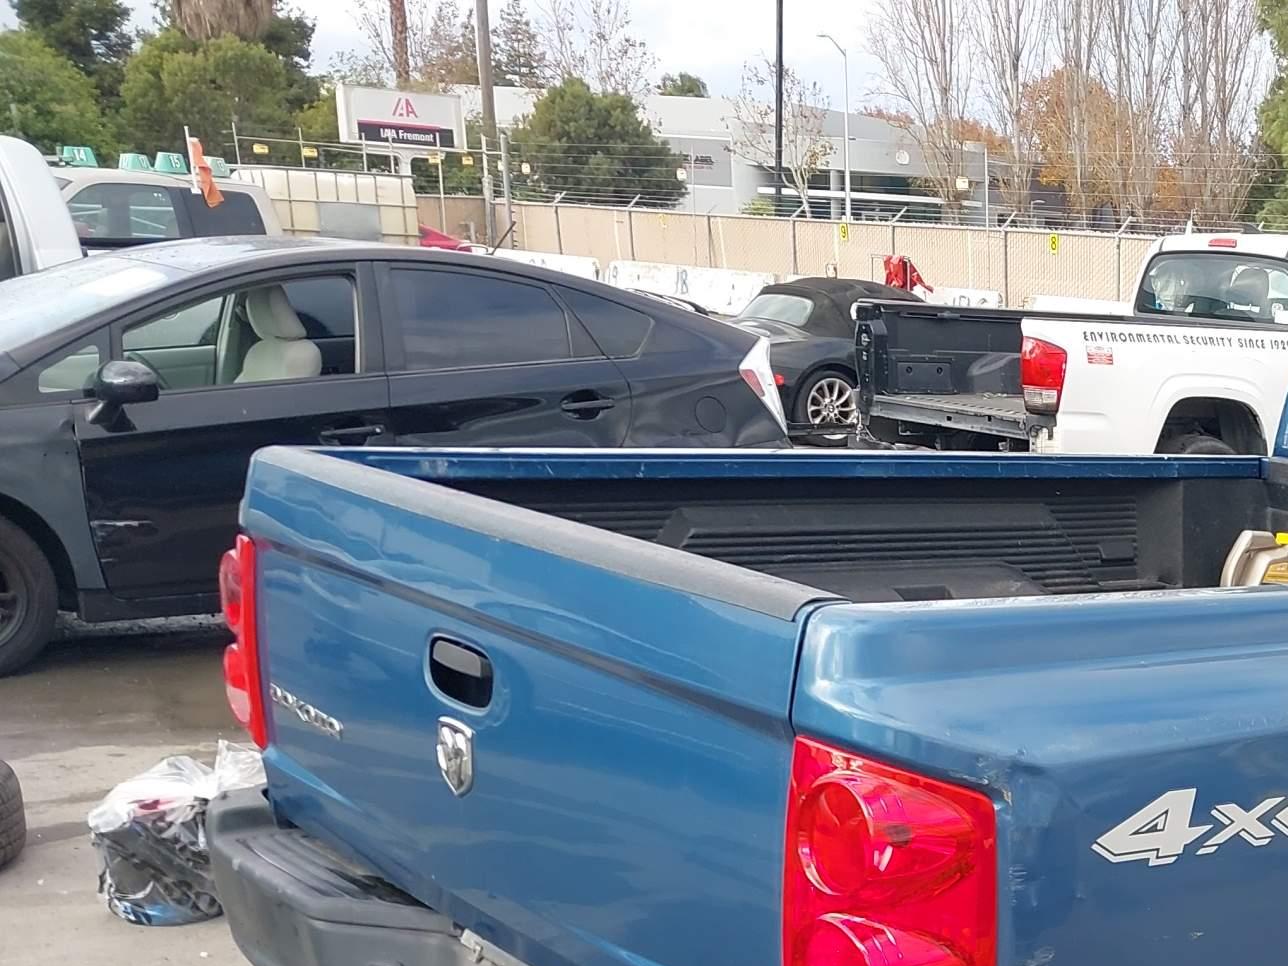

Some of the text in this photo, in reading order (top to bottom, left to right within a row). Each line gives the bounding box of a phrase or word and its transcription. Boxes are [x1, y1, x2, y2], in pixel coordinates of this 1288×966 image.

[399, 130, 434, 142] Fremont
[73, 149, 87, 161] 14
[168, 154, 181, 168] 15
[1051, 236, 1057, 250] 8
[1083, 331, 1181, 344] ENVIRONMENTAL
[1183, 335, 1233, 347] SECURITY
[1238, 337, 1266, 349] SINCE
